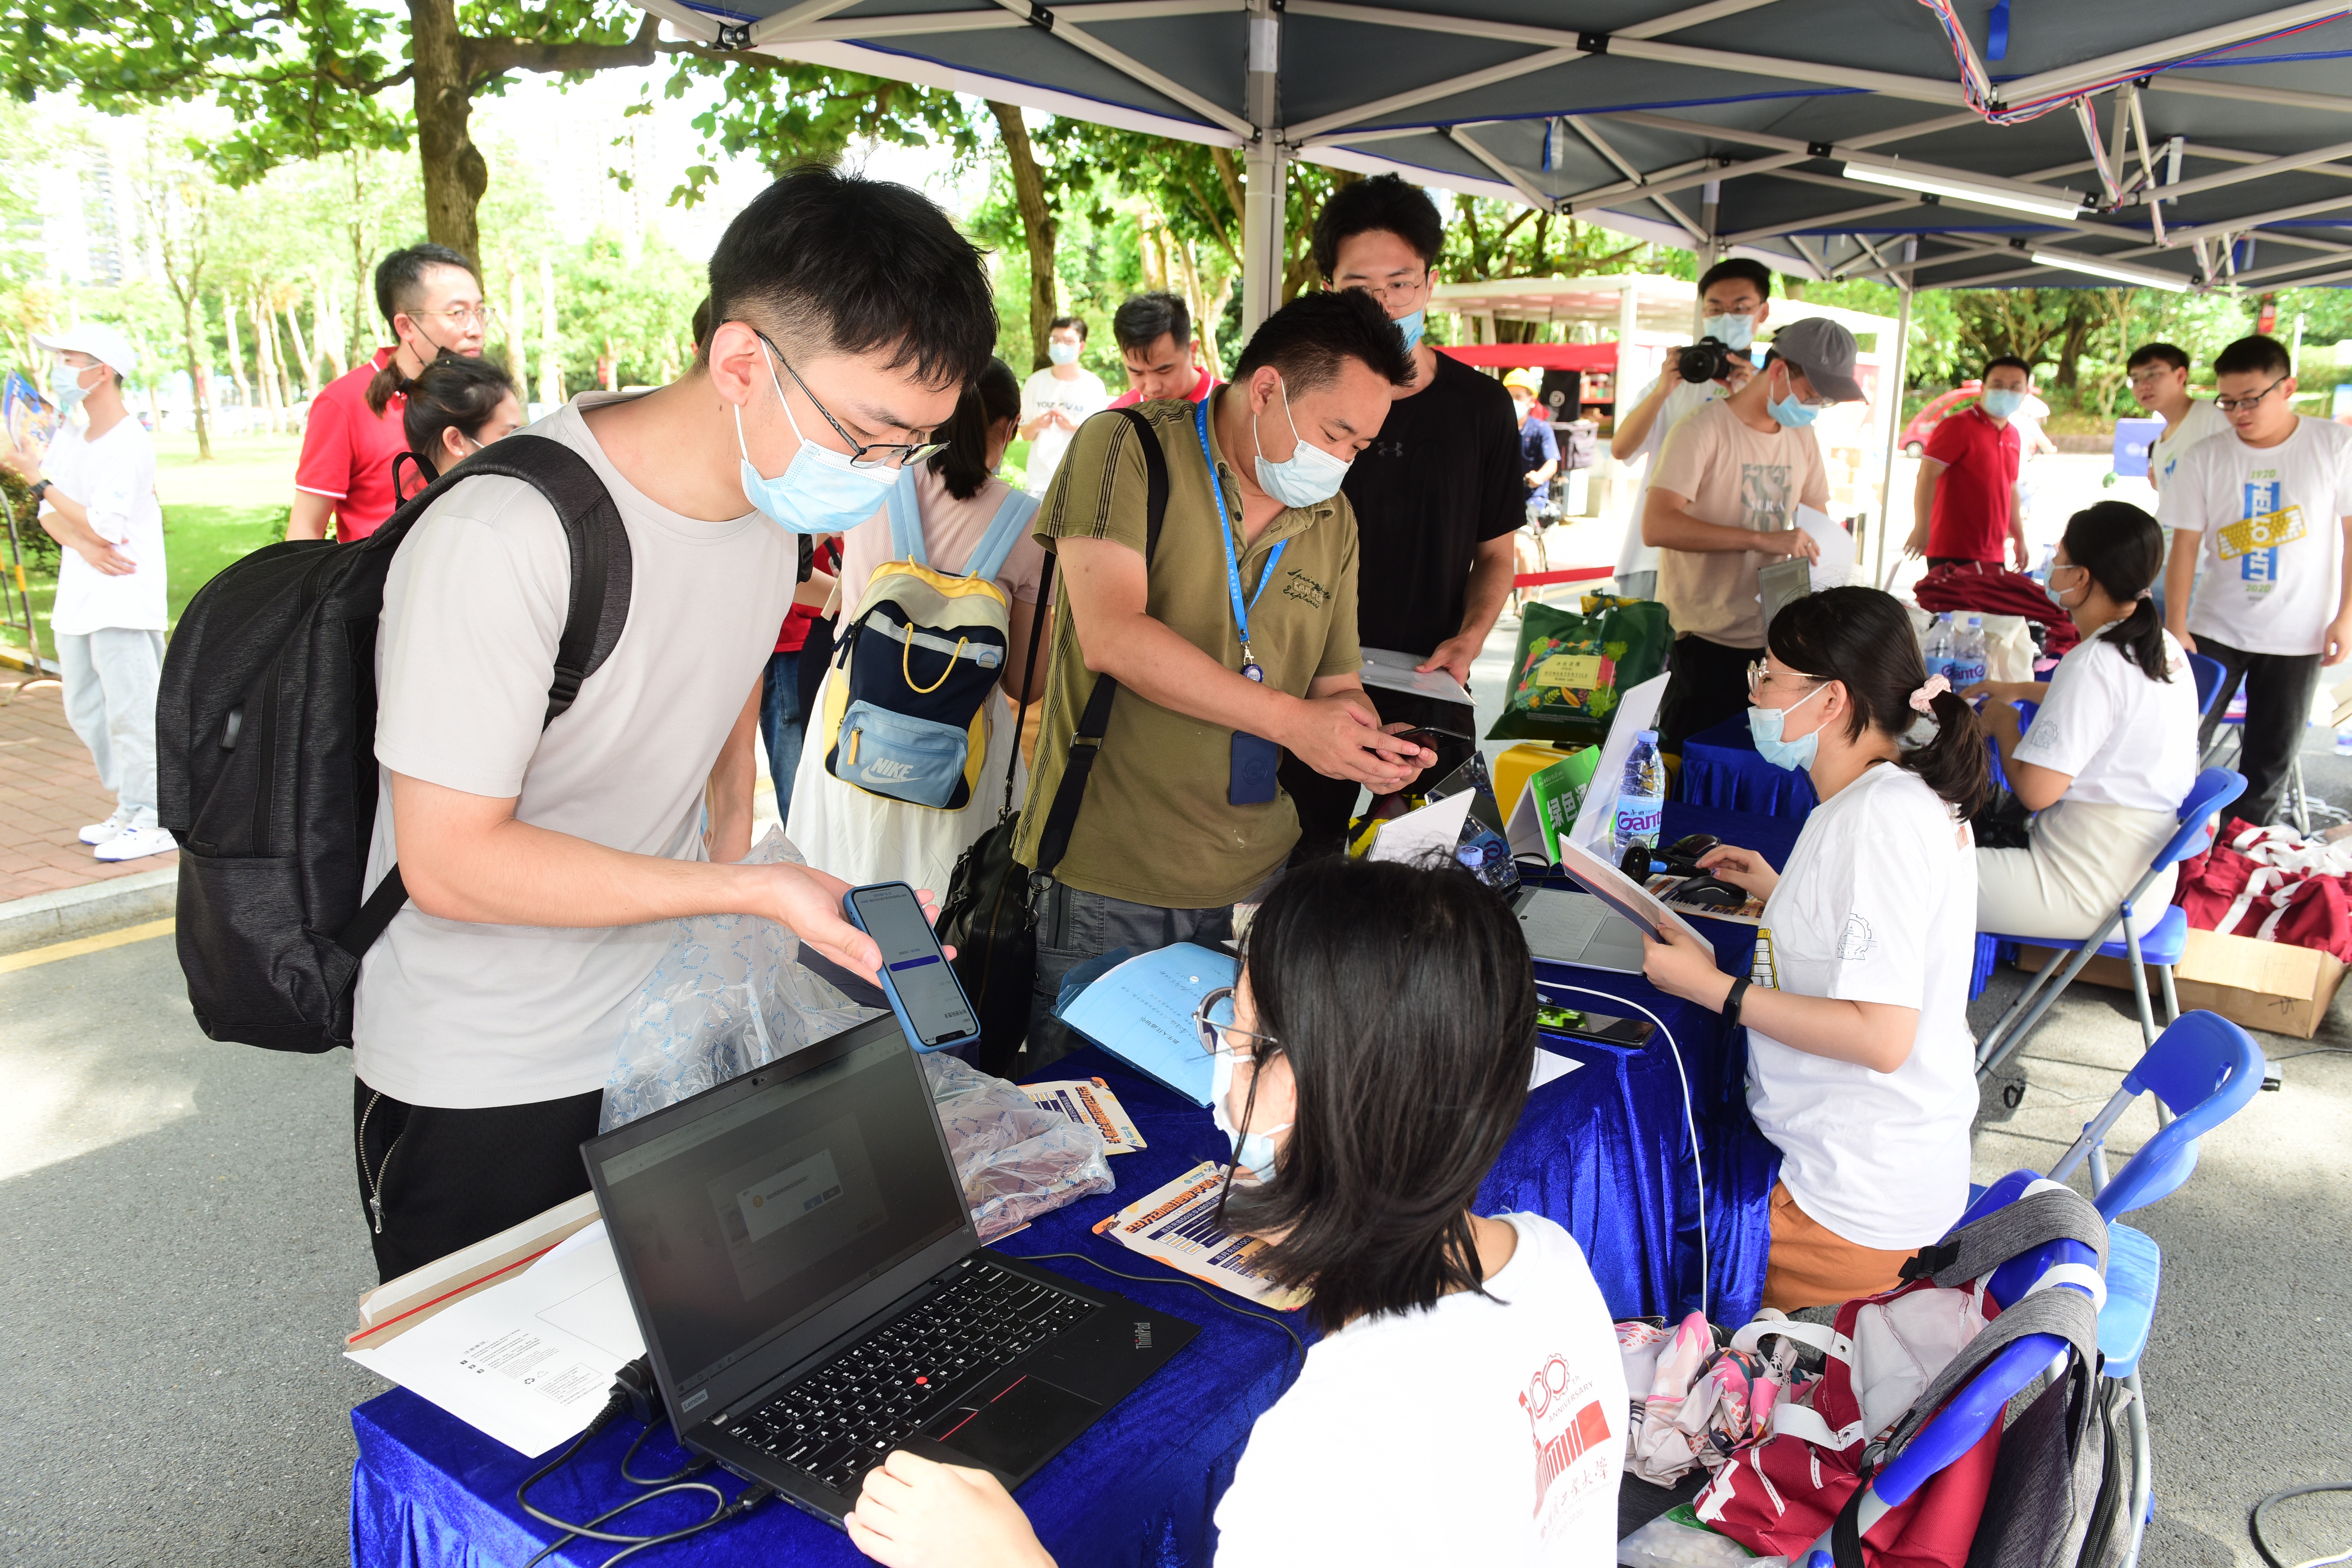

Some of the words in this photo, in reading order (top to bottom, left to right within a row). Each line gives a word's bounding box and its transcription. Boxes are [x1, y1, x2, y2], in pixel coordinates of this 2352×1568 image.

[2251, 469, 2277, 479] 1920
[1225, 546, 1234, 567] PCNL
[2245, 584, 2272, 593] 2020
[870, 757, 914, 779] NIKE
[733, 951, 749, 962] POLO
[1075, 1085, 1122, 1144] 29元动感地带学霸卡
[955, 1127, 970, 1139] POLO
[1122, 1173, 1227, 1234] 29元动感地带学霸卡
[989, 1272, 1003, 1281] Backspace
[1134, 1322, 1152, 1349] ThinkPad
[684, 1394, 706, 1409] Lenovo
[1548, 1381, 1594, 1424] ANNIVERSARY
[787, 1446, 807, 1460] CapsLock
